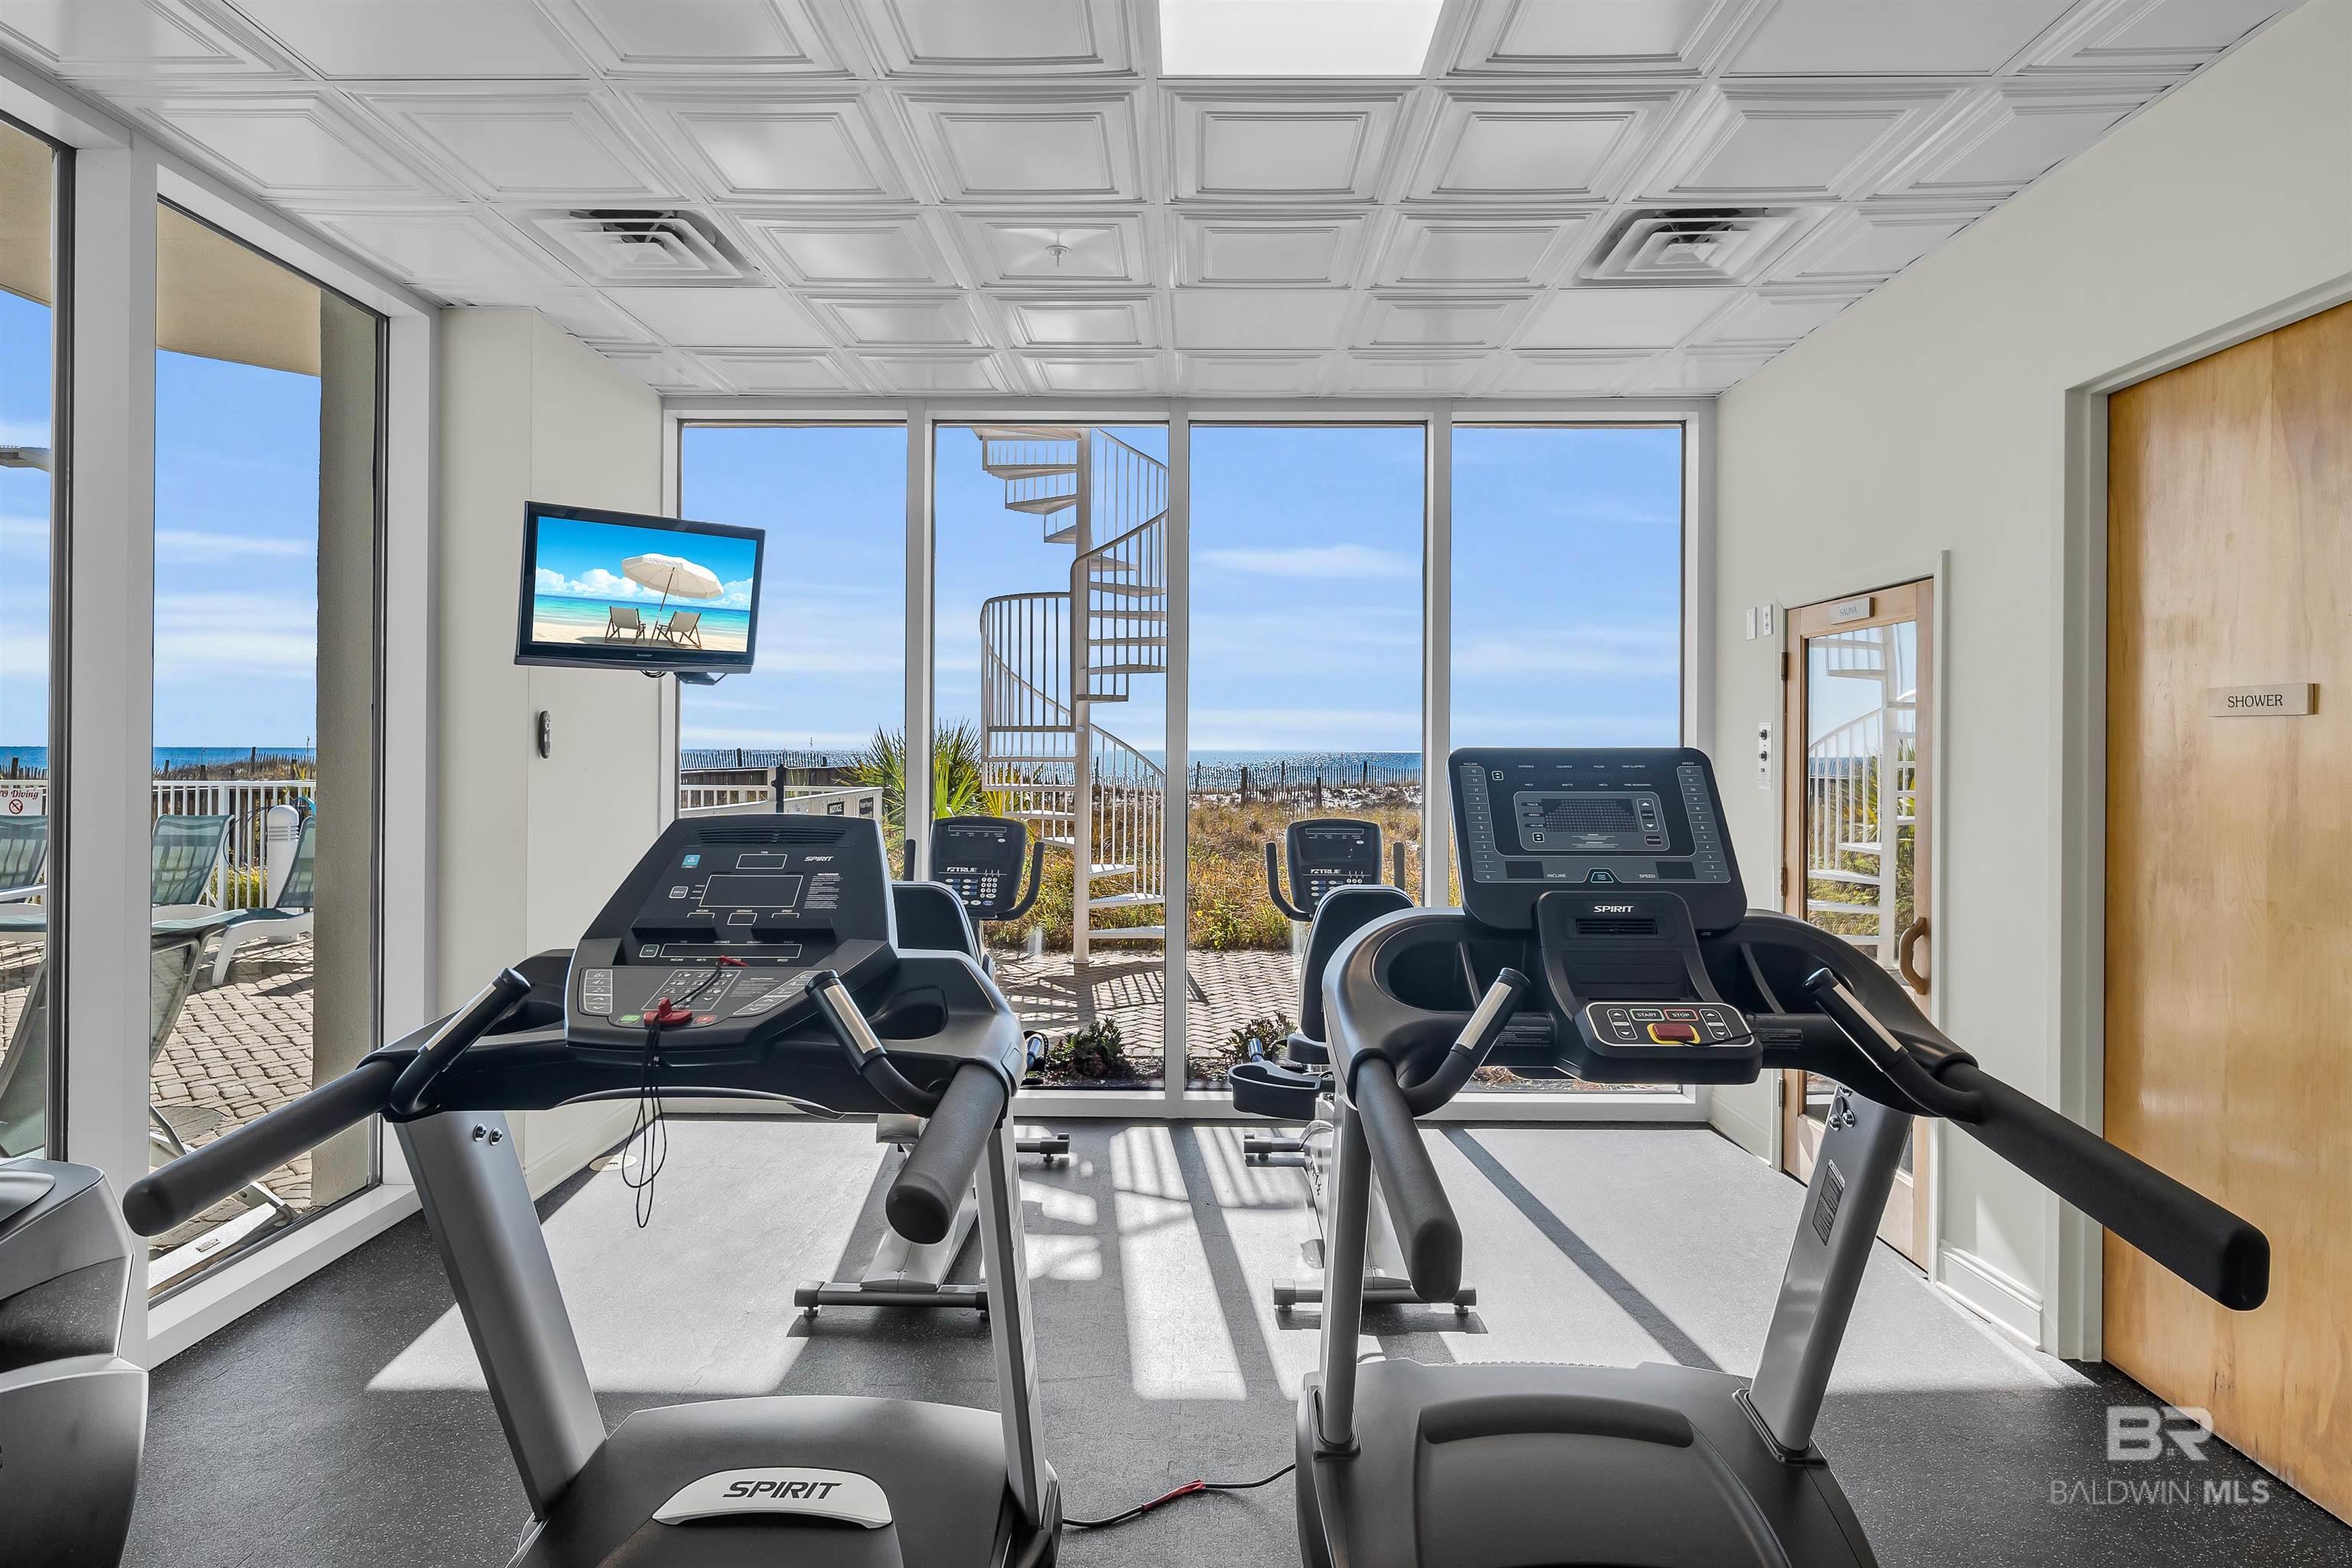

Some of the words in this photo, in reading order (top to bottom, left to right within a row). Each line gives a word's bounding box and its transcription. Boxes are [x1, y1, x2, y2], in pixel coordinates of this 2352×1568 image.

[1839, 606, 1857, 617] SAUNA
[2227, 694, 2283, 708] SHOWER
[11, 789, 39, 800] Diving
[722, 1481, 842, 1499] SPIRIT
